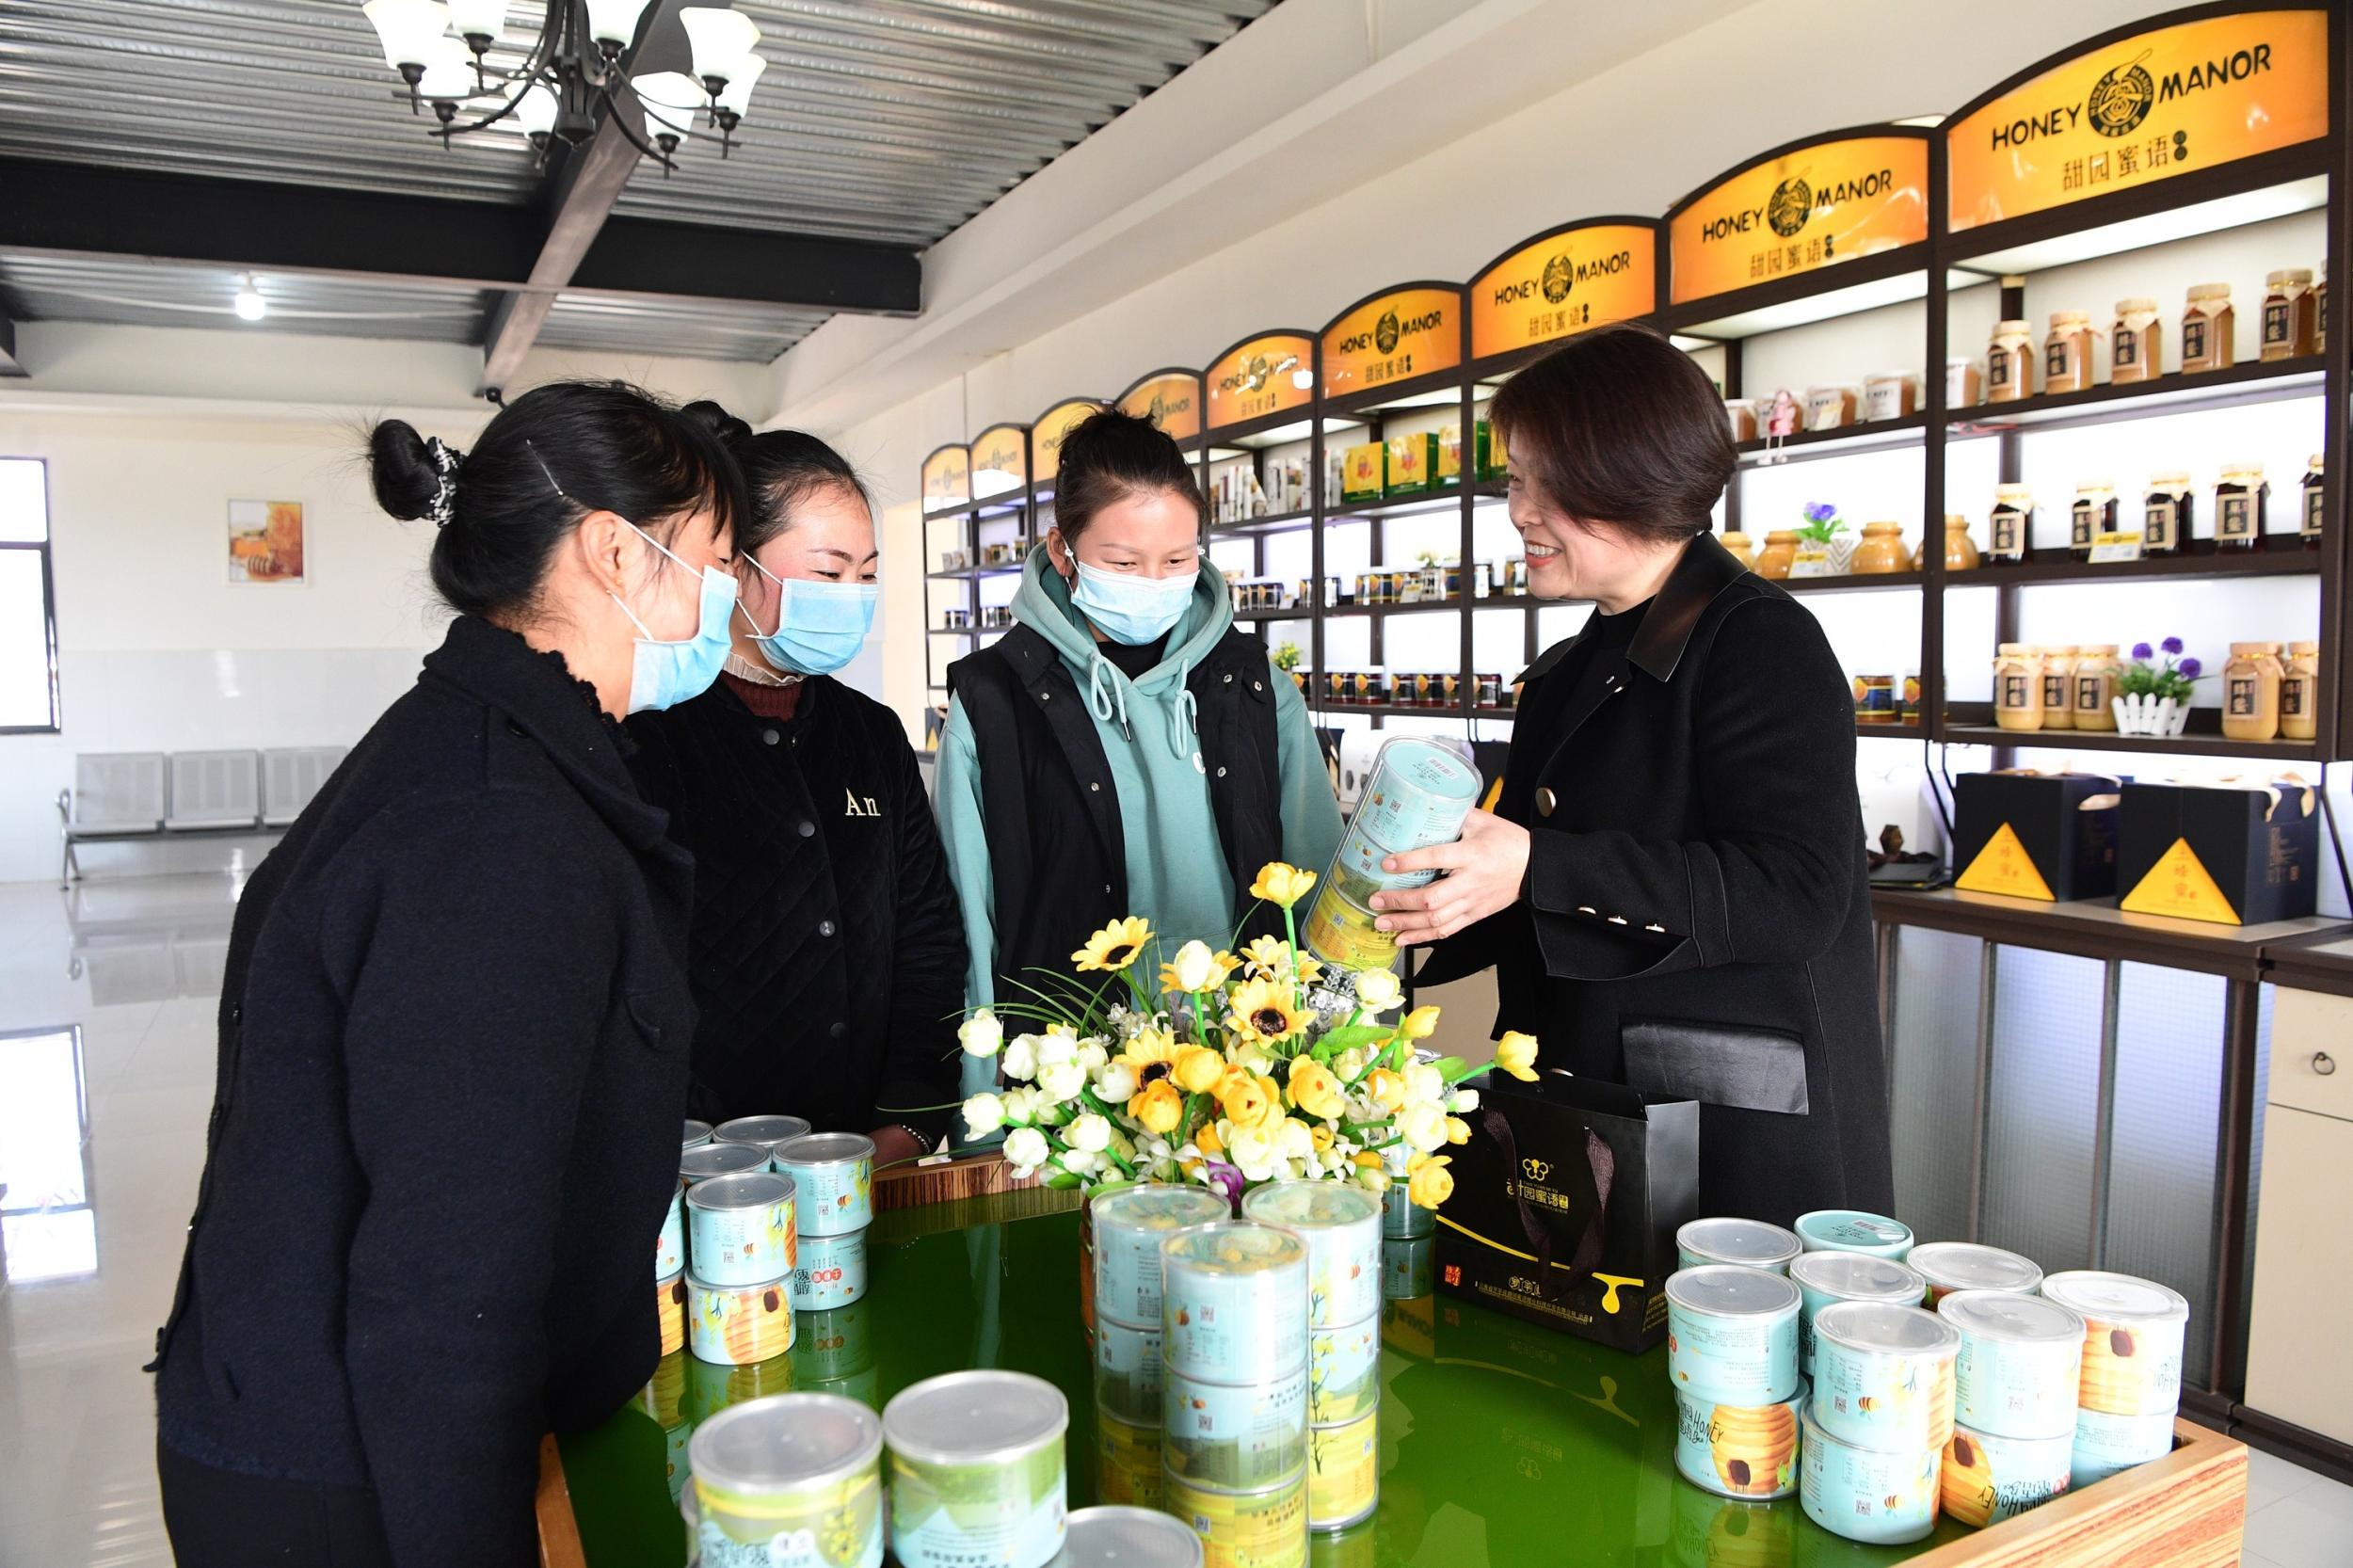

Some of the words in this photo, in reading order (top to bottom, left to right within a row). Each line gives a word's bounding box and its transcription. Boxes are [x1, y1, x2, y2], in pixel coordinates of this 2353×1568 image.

[1992, 103, 2081, 151] HONEY
[2158, 43, 2271, 104] MANOR
[2062, 136, 2169, 191] 甜园蜜语
[1703, 207, 1763, 243] HONEY
[1816, 168, 1892, 208] MANOR
[1495, 279, 1539, 306] HONEY
[1576, 251, 1630, 283] MANOR
[1339, 332, 1373, 356] HONEY
[1401, 311, 1442, 338] MANOR
[844, 787, 881, 816] An
[1693, 1410, 1724, 1445] HONEY
[1977, 1485, 2019, 1517] HONEY
